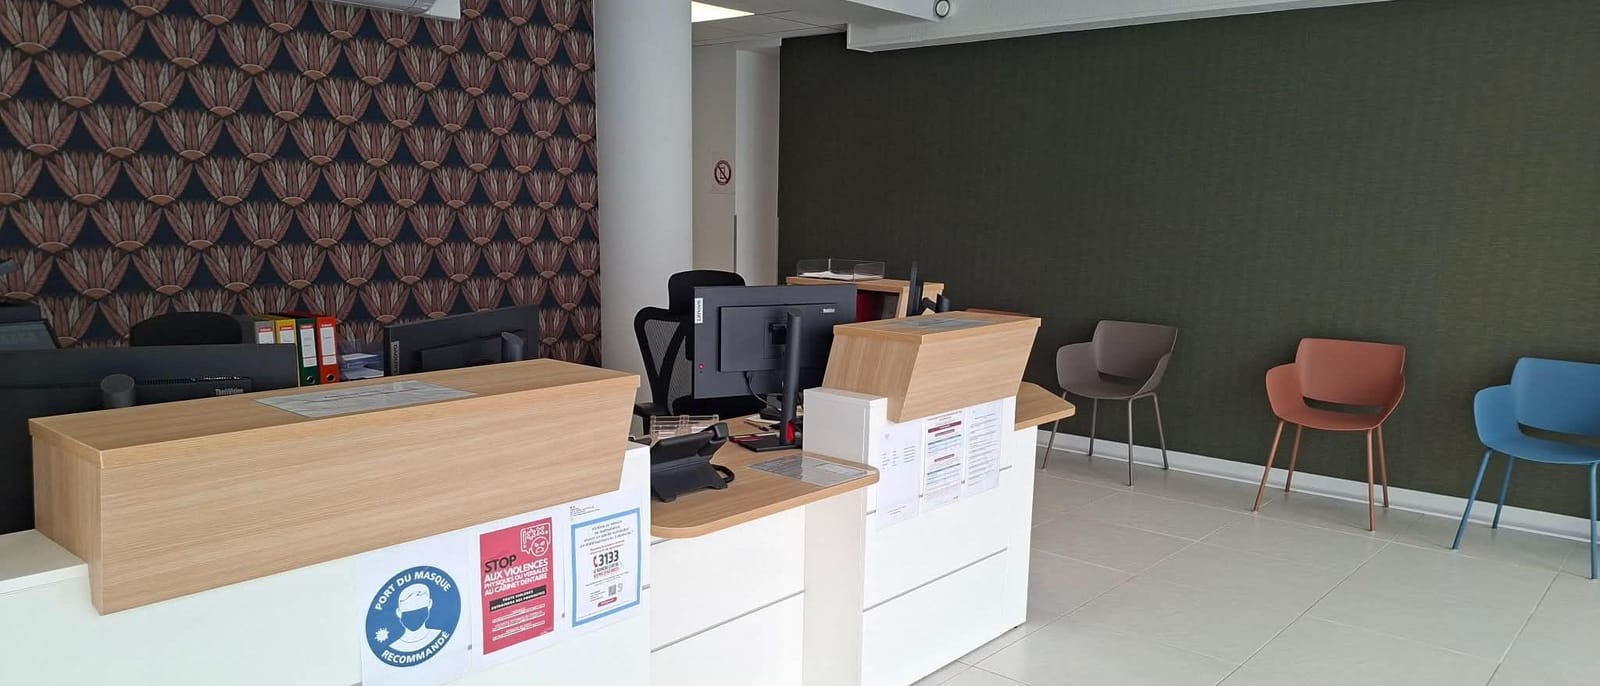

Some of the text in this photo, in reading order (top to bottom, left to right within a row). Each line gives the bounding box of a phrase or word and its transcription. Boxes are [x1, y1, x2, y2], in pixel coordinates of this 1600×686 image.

[485, 554, 517, 573] STOP
[598, 549, 619, 567] 3133
[485, 558, 549, 583] AUX VIOLENCES
[375, 570, 452, 611] PORT DU MASQUE
[484, 587, 494, 596] AU
